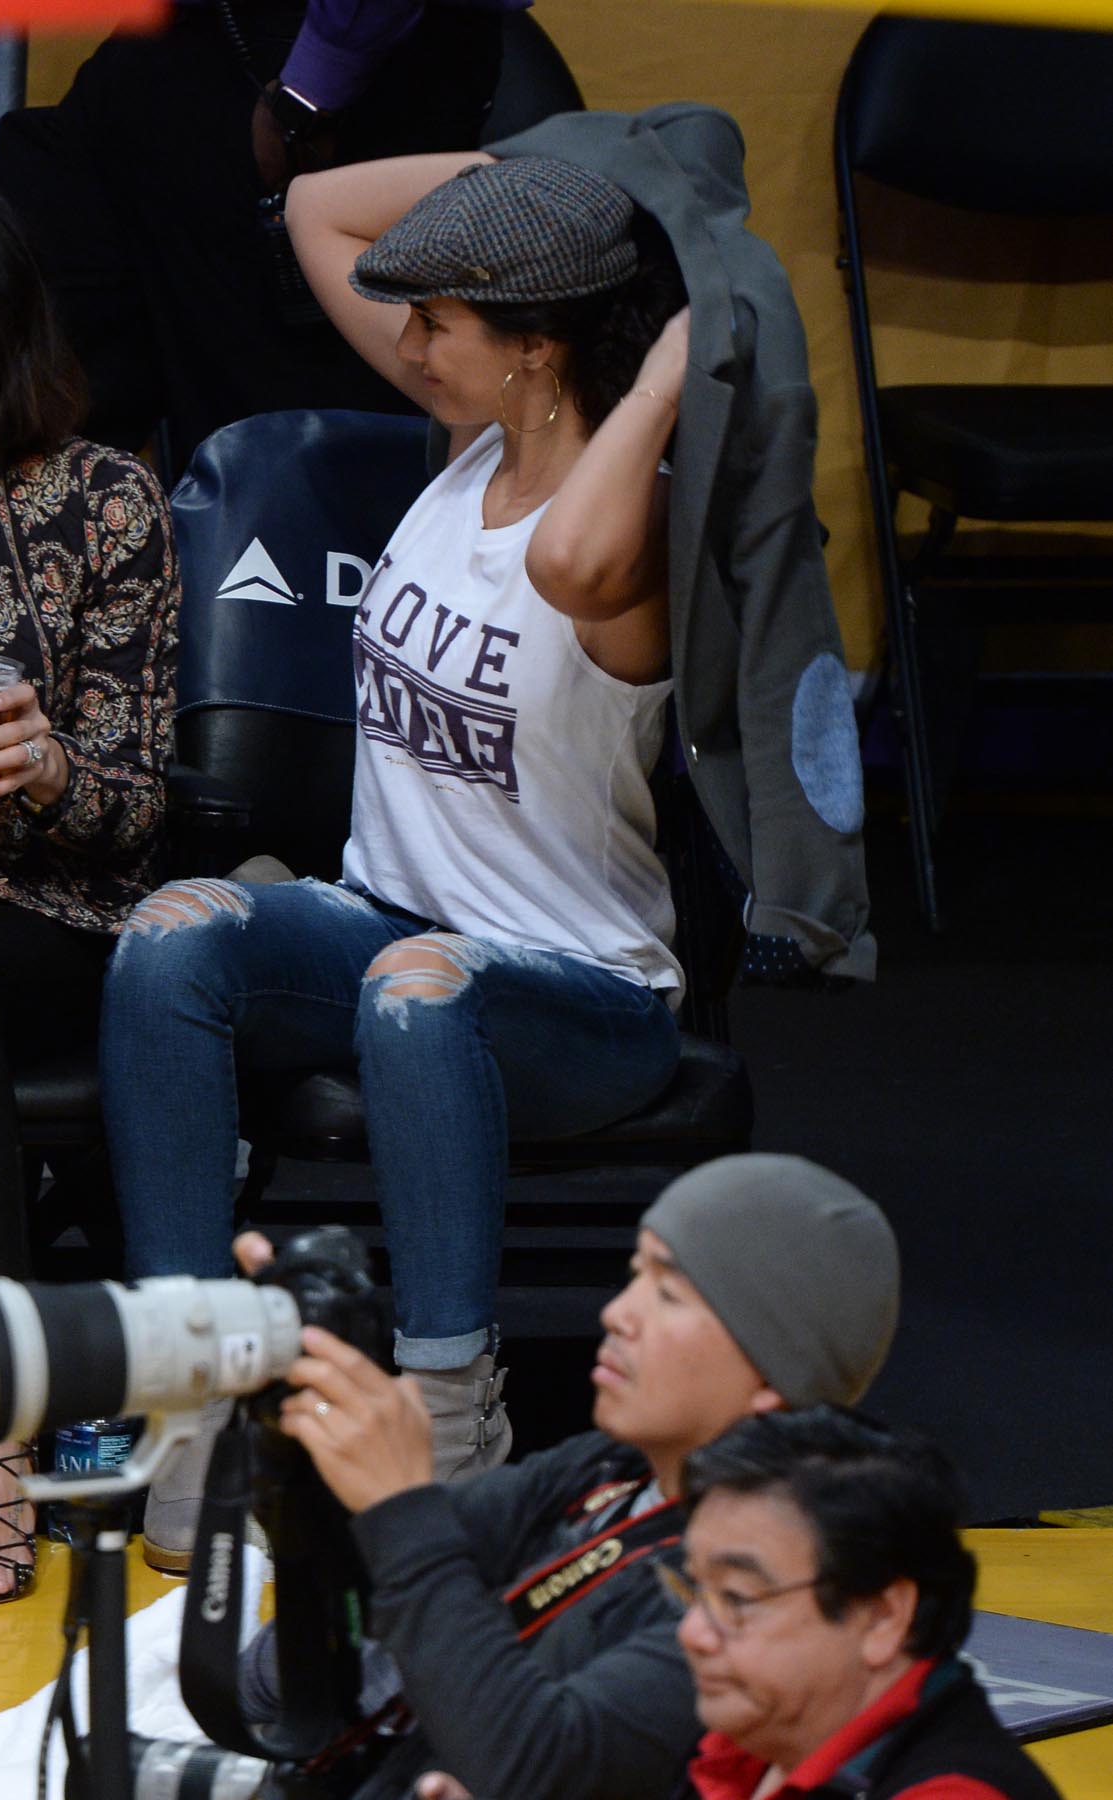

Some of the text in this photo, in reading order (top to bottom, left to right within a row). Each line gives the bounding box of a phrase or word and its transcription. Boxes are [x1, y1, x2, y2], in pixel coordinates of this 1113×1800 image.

[358, 552, 520, 698] LOVE
[201, 1532, 234, 1622] Canon
[528, 1538, 622, 1609] Canon
